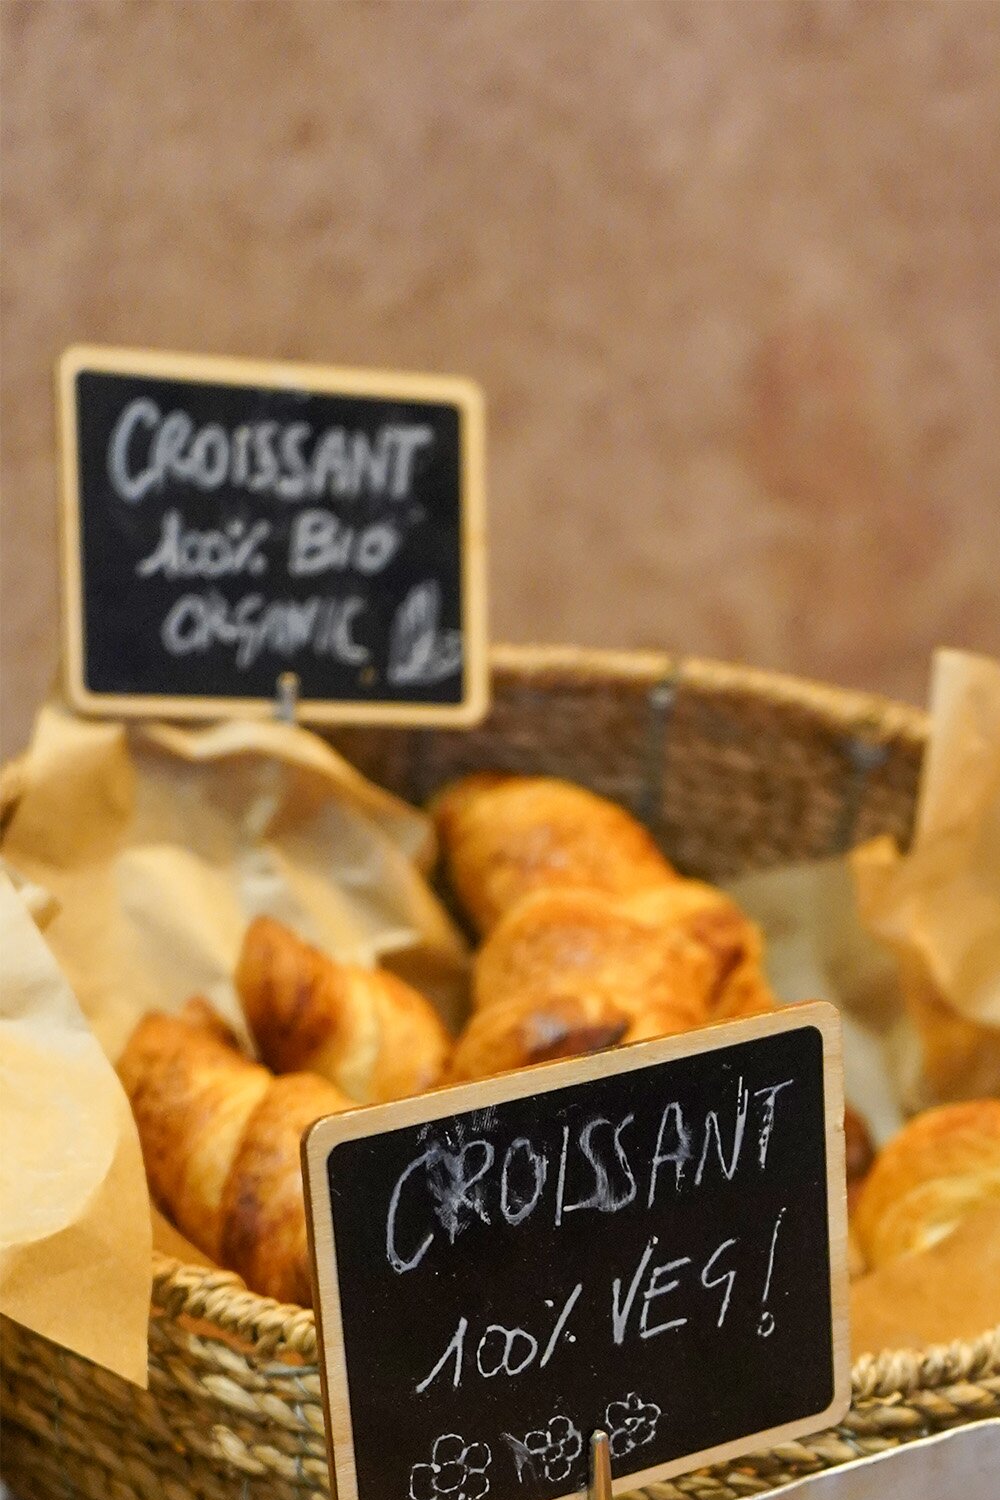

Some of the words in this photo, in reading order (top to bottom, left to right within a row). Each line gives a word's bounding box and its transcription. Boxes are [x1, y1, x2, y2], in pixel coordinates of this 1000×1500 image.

[110, 398, 434, 500] CROISSANT
[137, 508, 271, 577] 100%
[290, 509, 398, 574] BIO
[386, 1077, 794, 1273] CROISSANT
[416, 1283, 583, 1393] 100%
